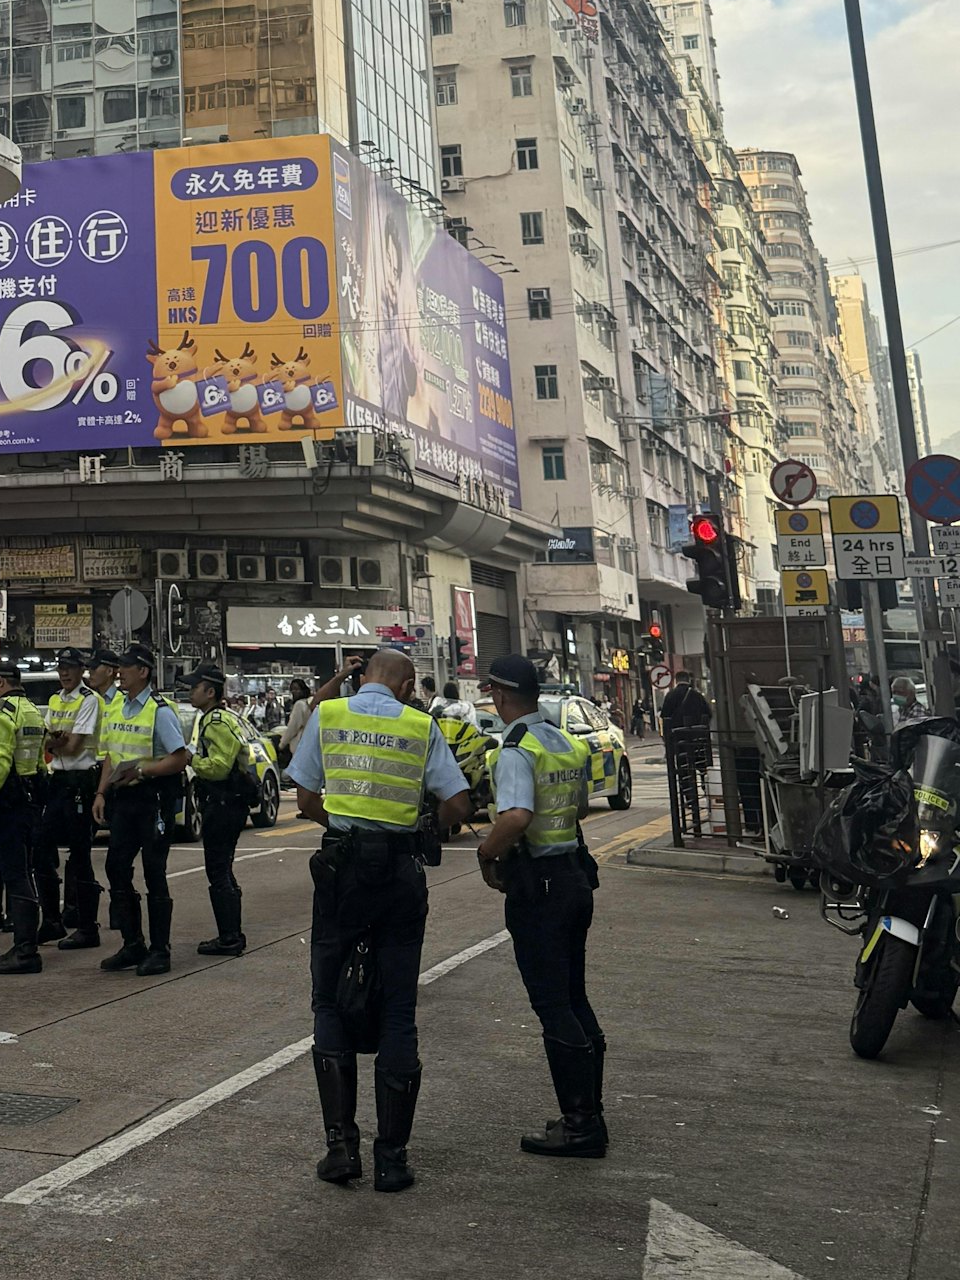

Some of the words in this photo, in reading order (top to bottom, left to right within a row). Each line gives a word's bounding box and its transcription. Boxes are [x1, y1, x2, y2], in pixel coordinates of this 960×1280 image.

[185, 164, 303, 196] 永久免年費
[195, 204, 296, 234] 迎新優惠
[191, 236, 330, 325] 700
[167, 287, 196, 303] 高達
[168, 306, 197, 324] HK$
[203, 384, 229, 406] 6%
[263, 388, 285, 406] 6%
[315, 388, 336, 406] 6%
[124, 410, 142, 424] 2%
[936, 529, 960, 537] Taxis
[791, 538, 811, 548] End
[843, 539, 865, 552] 24
[869, 539, 895, 552] hrs
[788, 550, 817, 562] 終止
[851, 555, 893, 578] 全日
[939, 558, 958, 573] 12
[947, 581, 960, 589] En
[353, 730, 394, 748] POLICE
[914, 790, 941, 806] POLICE
